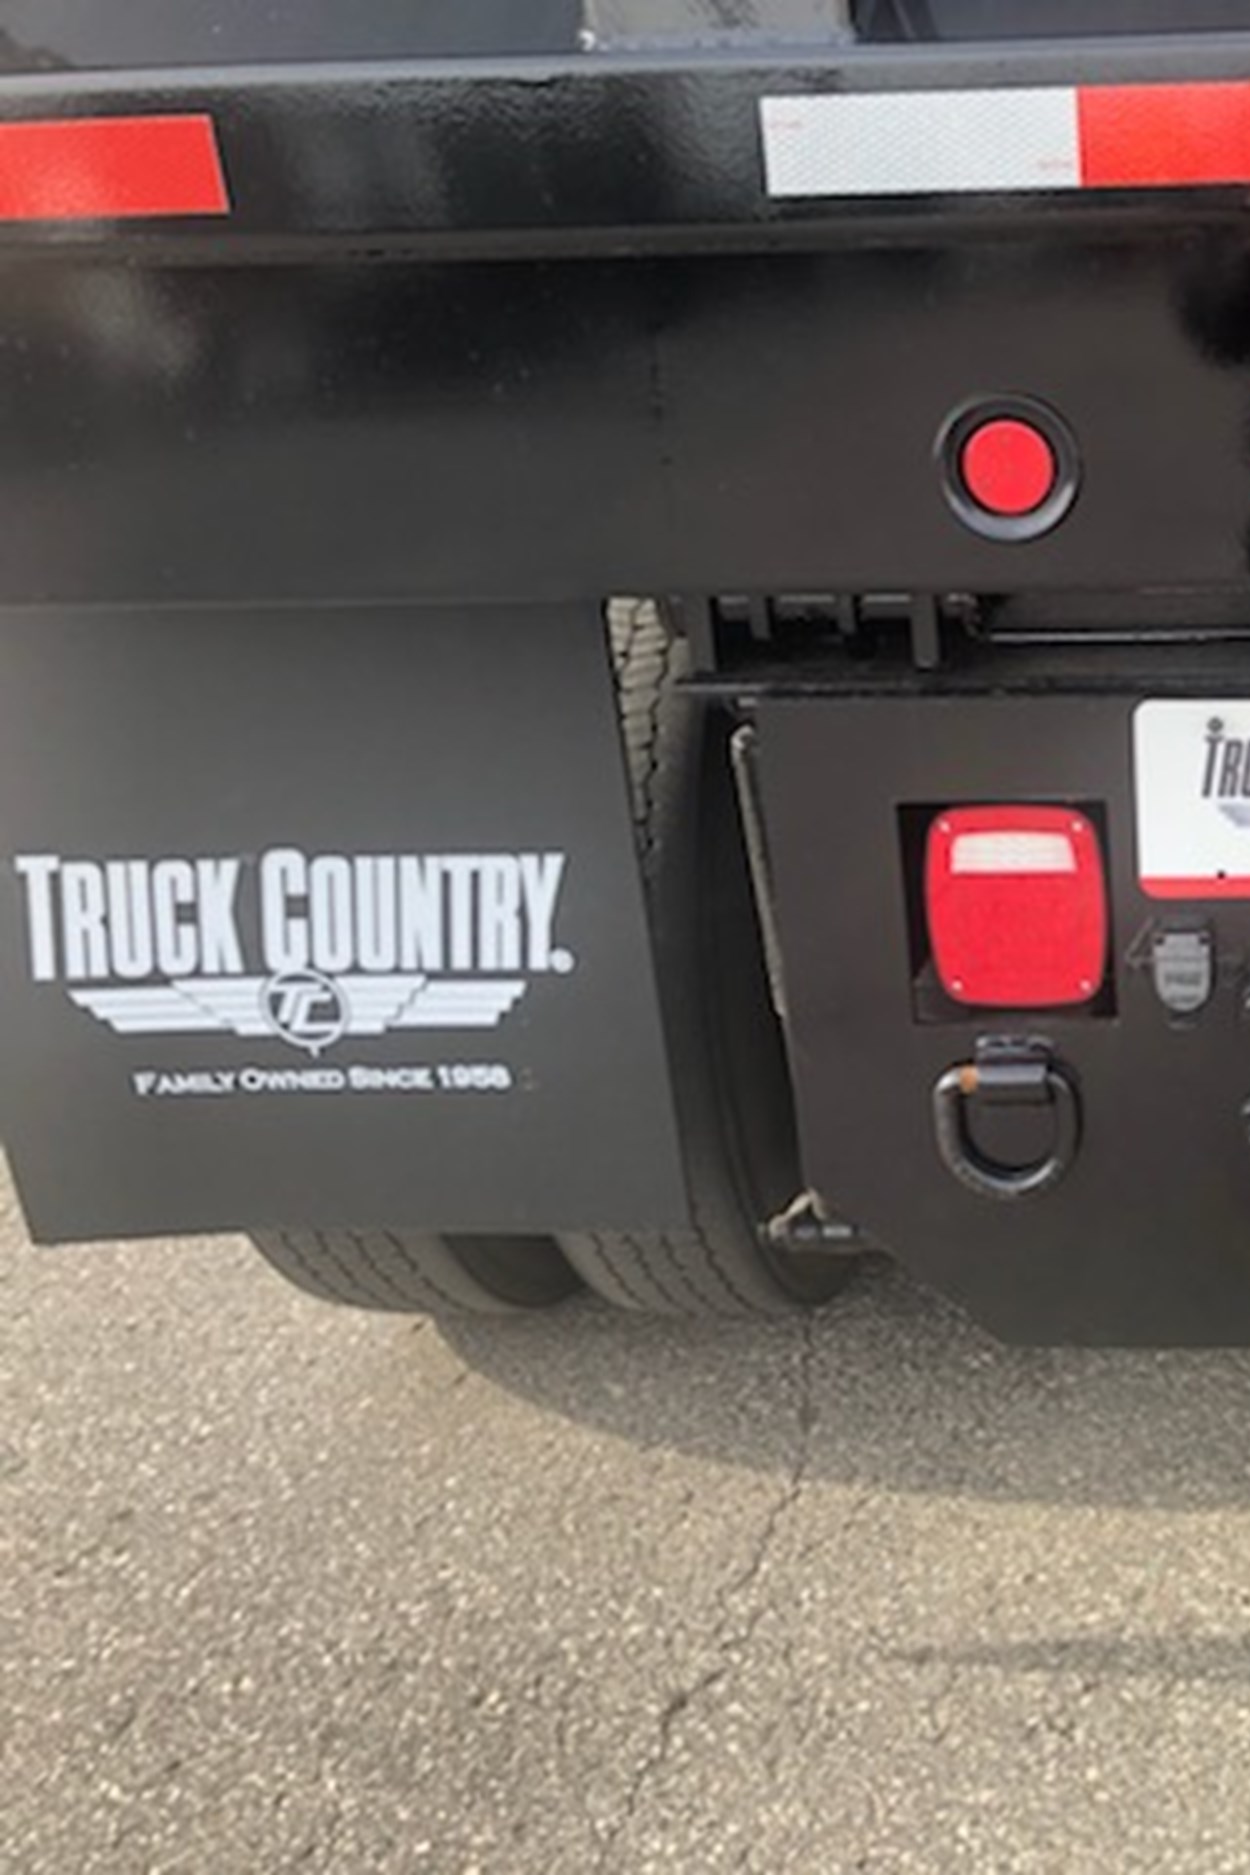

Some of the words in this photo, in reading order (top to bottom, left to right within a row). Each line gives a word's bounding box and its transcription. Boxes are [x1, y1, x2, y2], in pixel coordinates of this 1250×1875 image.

[15, 855, 243, 980] TRUCK
[133, 1071, 236, 1096] FAMILY
[238, 1067, 346, 1092] OWNED
[348, 1065, 434, 1090] SINCE
